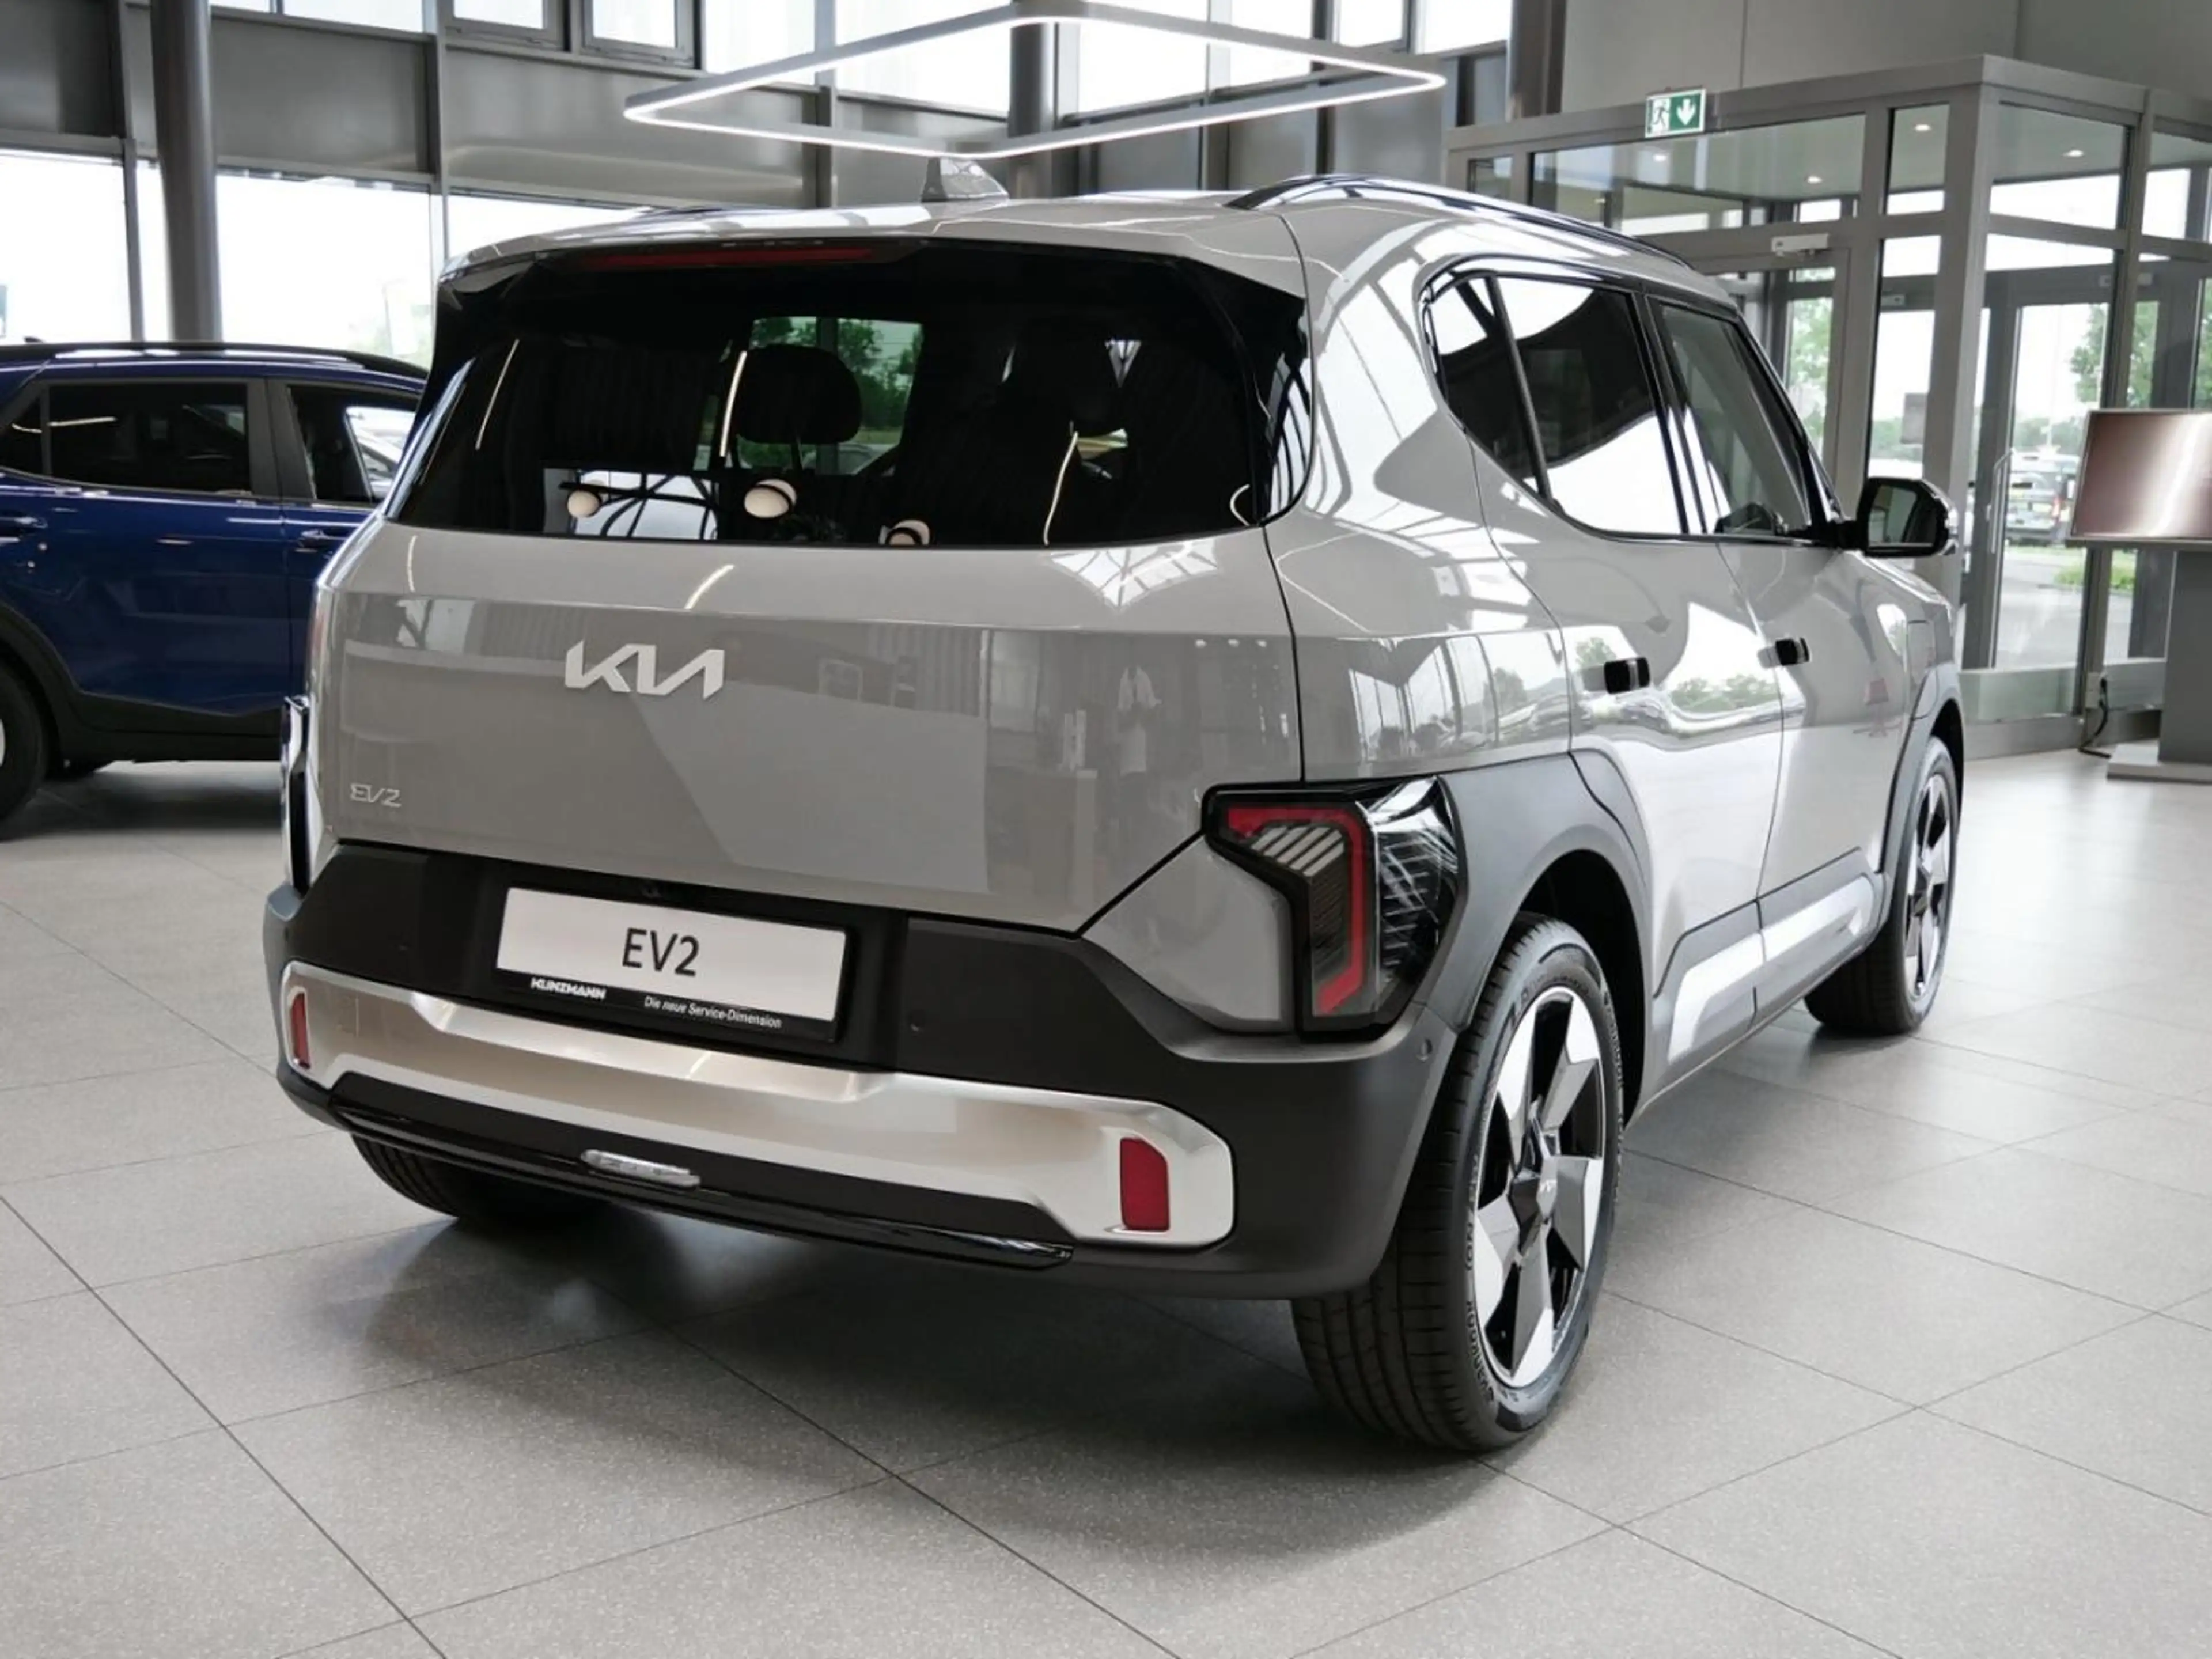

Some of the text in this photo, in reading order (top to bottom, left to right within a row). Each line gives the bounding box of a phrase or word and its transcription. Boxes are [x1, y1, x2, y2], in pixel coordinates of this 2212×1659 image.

[565, 639, 725, 700] KIA
[350, 783, 402, 808] EV2
[622, 927, 700, 977] EV2
[530, 977, 607, 1001] KUNZMANN
[644, 995, 662, 1009] Die
[662, 1001, 687, 1014] neue
